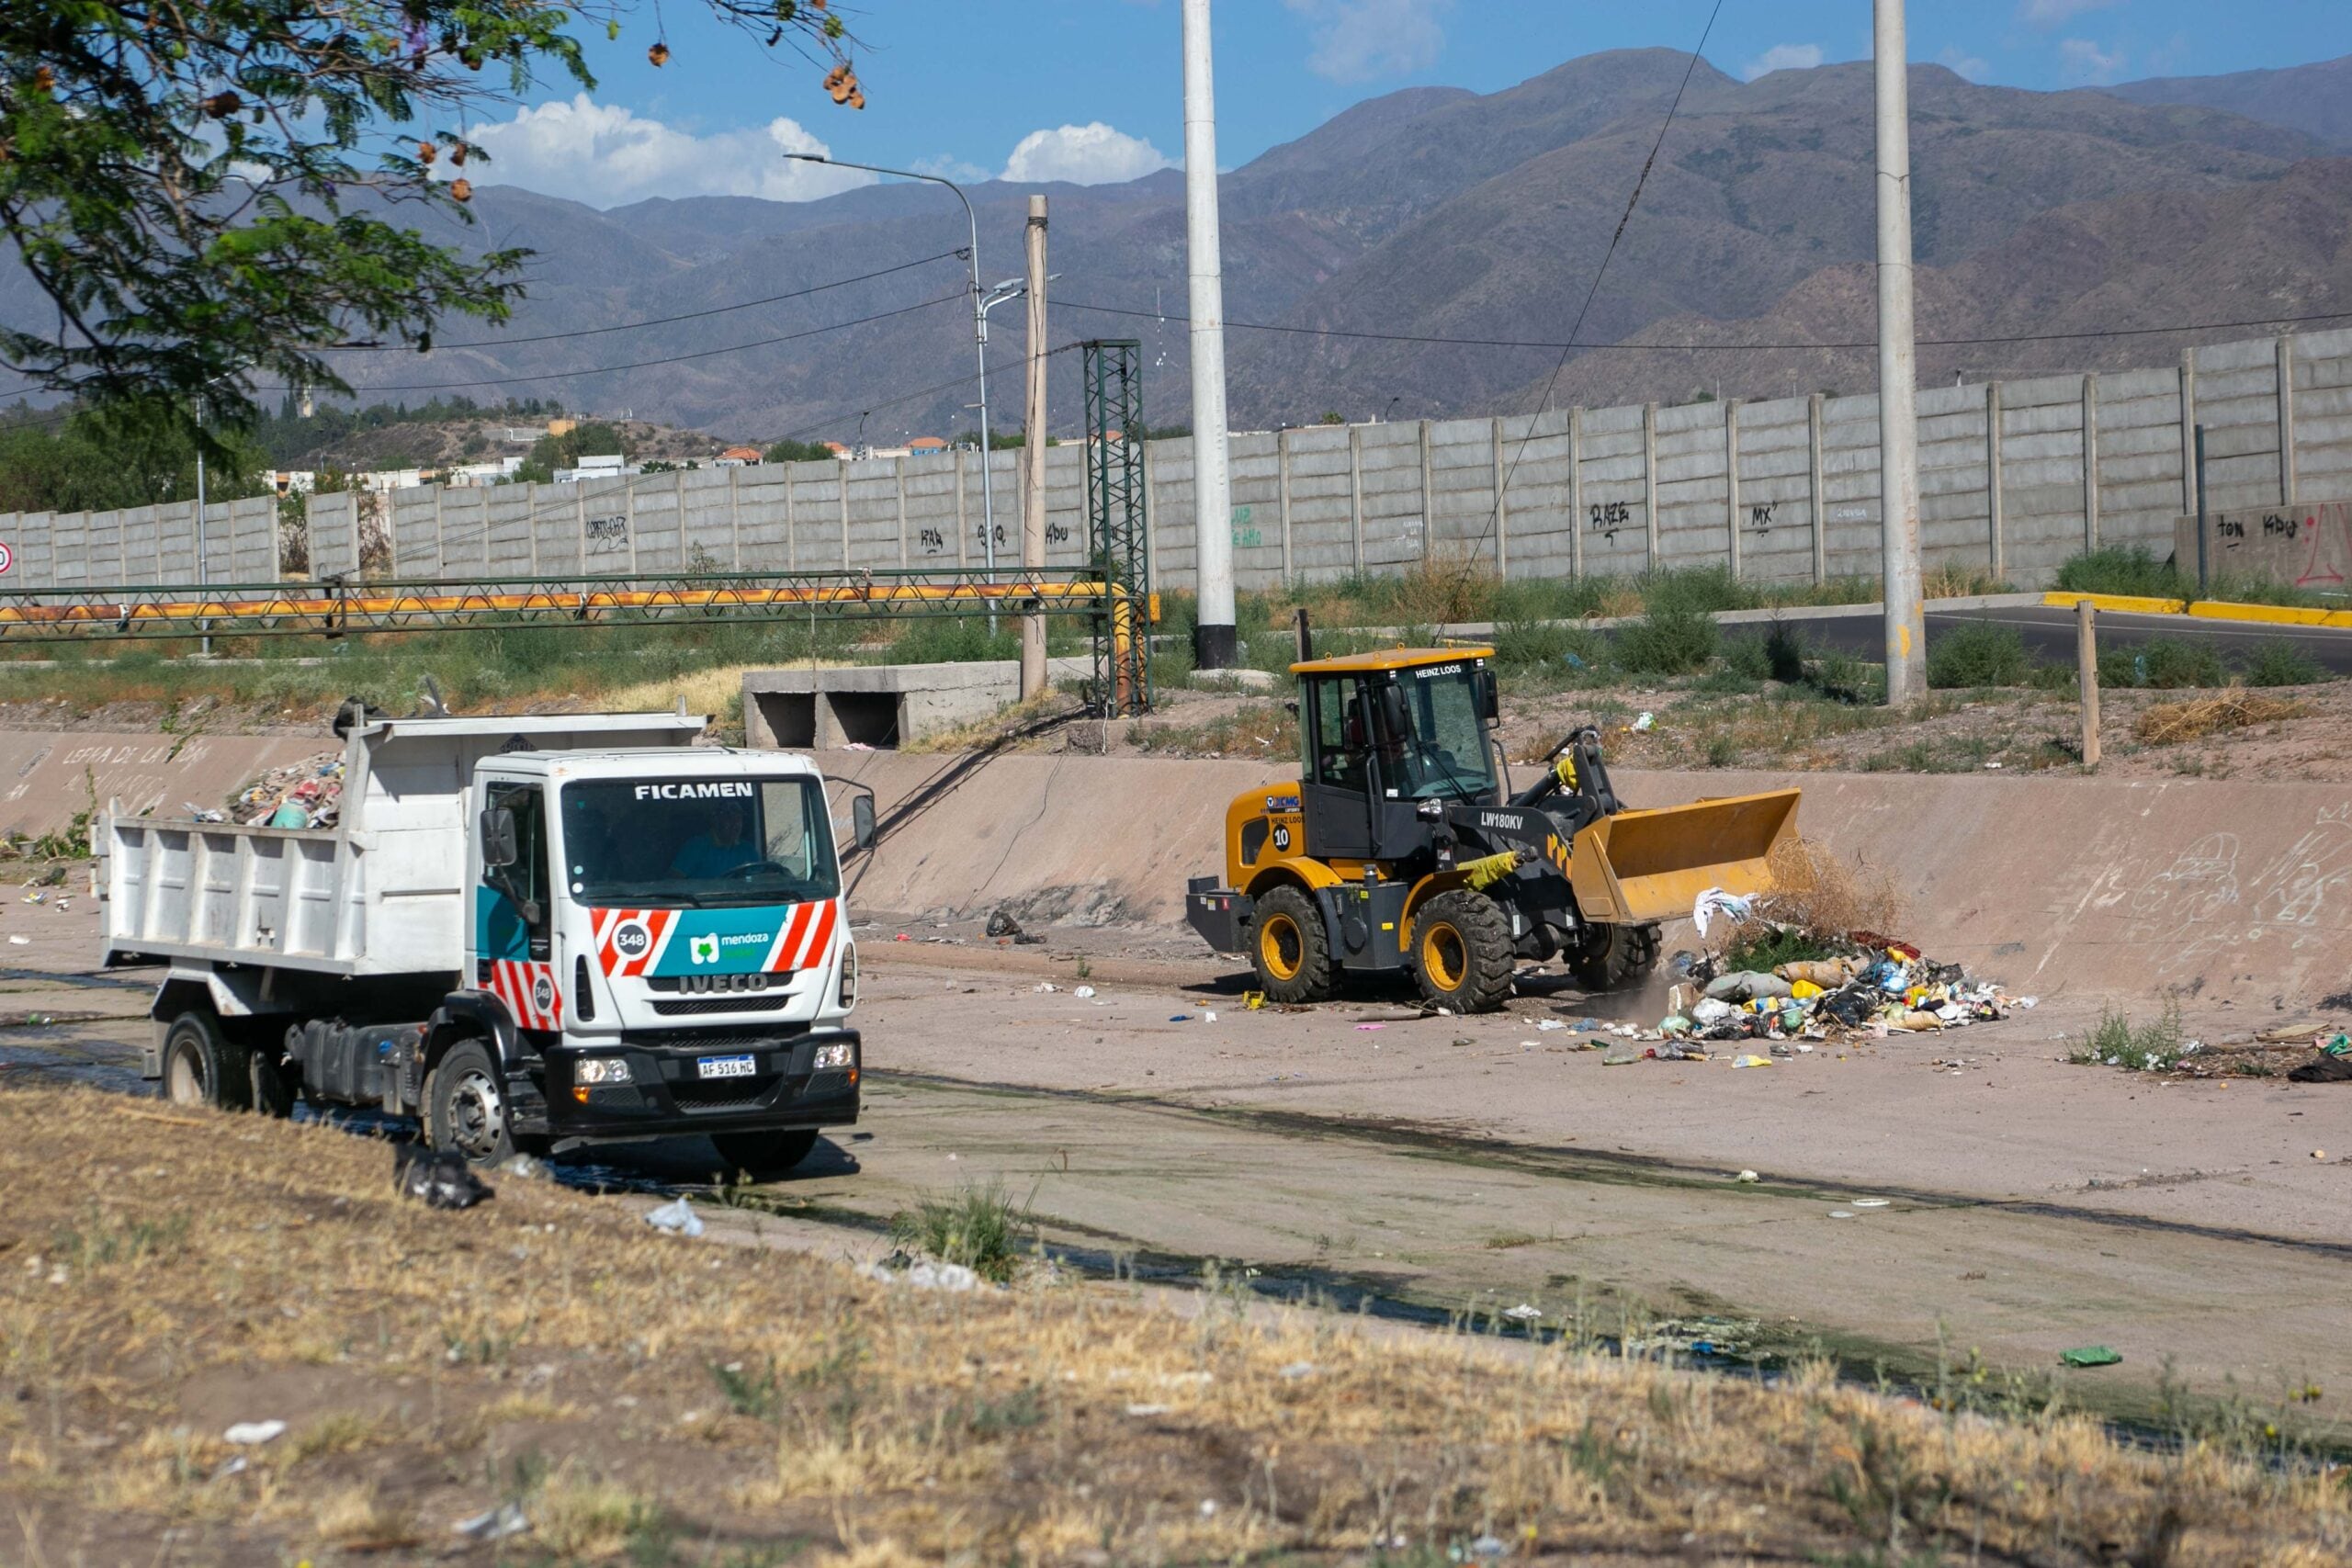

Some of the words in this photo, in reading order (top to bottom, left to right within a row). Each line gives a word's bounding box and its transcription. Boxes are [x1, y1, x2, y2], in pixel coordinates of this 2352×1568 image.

[1415, 668, 1440, 679] HEINZ
[1440, 664, 1462, 675] LOOS
[635, 783, 753, 800] FICAMEN
[1289, 816, 1306, 824] LOOS
[1481, 811, 1523, 829] LW180KV
[1274, 829, 1289, 846] 10
[618, 933, 645, 947] 348
[721, 932, 769, 946] mendoza
[679, 974, 768, 995] IVECO
[536, 987, 550, 999] 348
[703, 1064, 715, 1076] AF
[718, 1062, 737, 1075] 516
